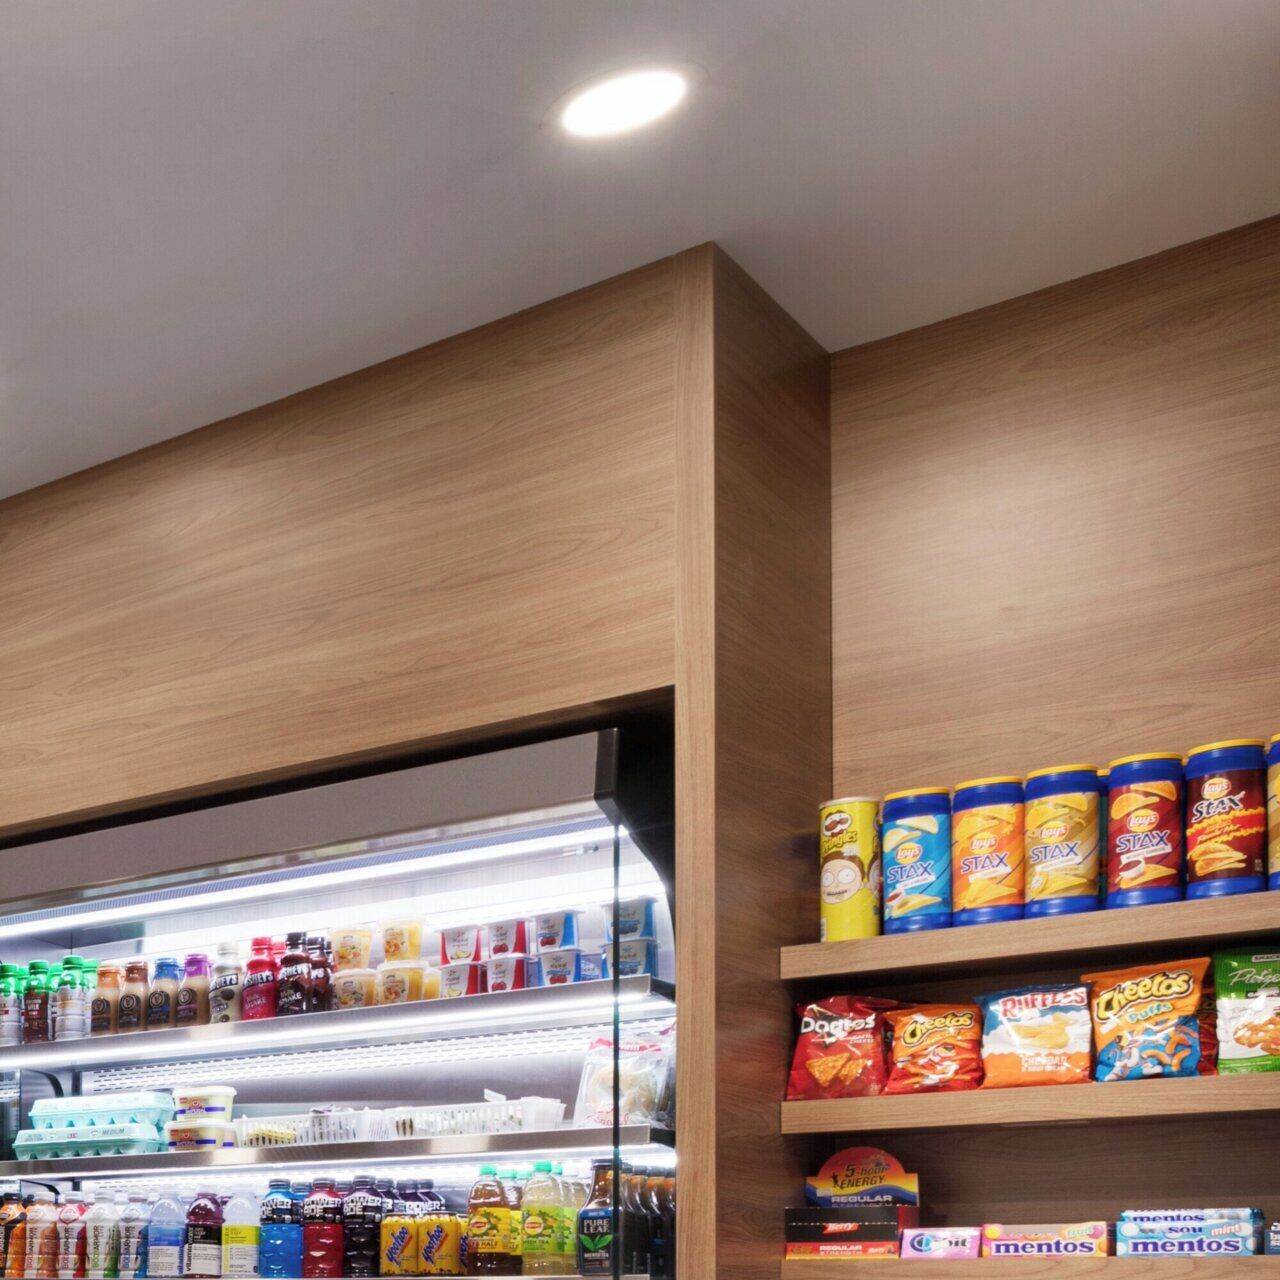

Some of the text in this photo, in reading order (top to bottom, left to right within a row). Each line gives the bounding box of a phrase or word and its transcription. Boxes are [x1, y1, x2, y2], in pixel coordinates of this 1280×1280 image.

[1030, 841, 1081, 862] STAX
[1116, 830, 1171, 852] STAX
[888, 861, 934, 883] STAX
[961, 853, 1009, 874] STAX
[1001, 987, 1087, 1018] RUFFLES
[1095, 971, 1194, 1023] Cheetos
[1128, 1001, 1173, 1023] Puffs
[801, 1013, 876, 1035] Doritos
[902, 1011, 975, 1048] Cheetos
[101, 1127, 125, 1135] MEDIUM
[840, 1175, 885, 1190] ENERGY
[304, 1199, 341, 1207] POWER
[832, 1195, 892, 1203] REGULAR
[1132, 1214, 1205, 1222] mentos
[1211, 1225, 1241, 1236] mint
[995, 1240, 1094, 1254] mentos
[1132, 1238, 1241, 1253] mentos
